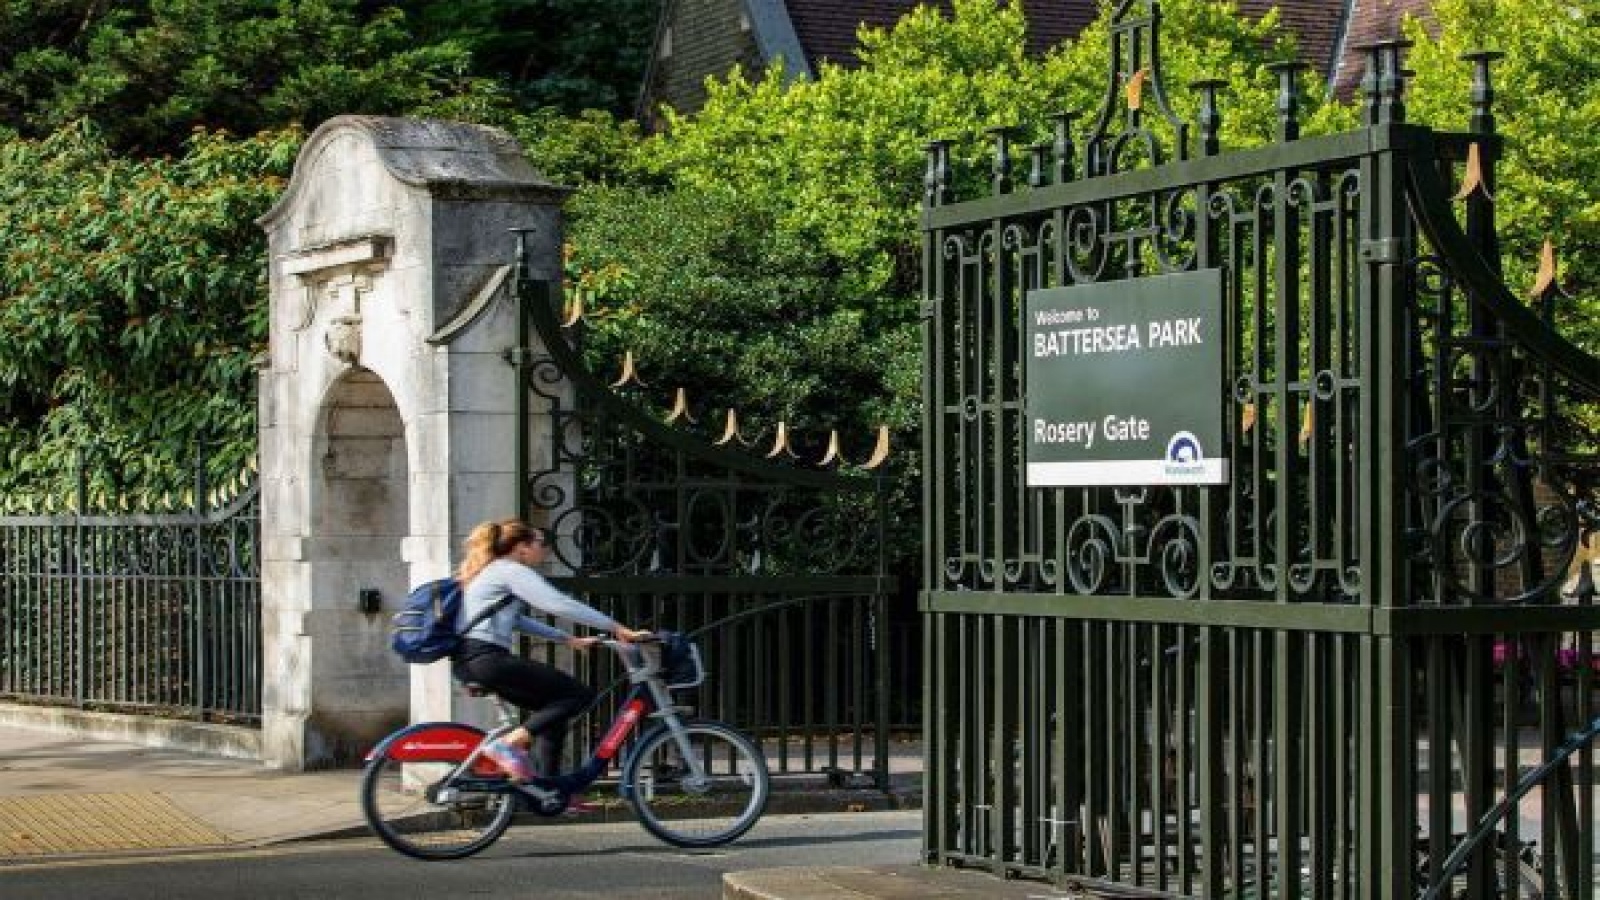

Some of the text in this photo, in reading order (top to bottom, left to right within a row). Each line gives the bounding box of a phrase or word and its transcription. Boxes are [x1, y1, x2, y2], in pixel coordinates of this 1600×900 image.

[1035, 306, 1100, 326] Welcome to
[1034, 317, 1203, 357] BATTERSEA PARK
[1034, 414, 1150, 449] Rosery Gate
